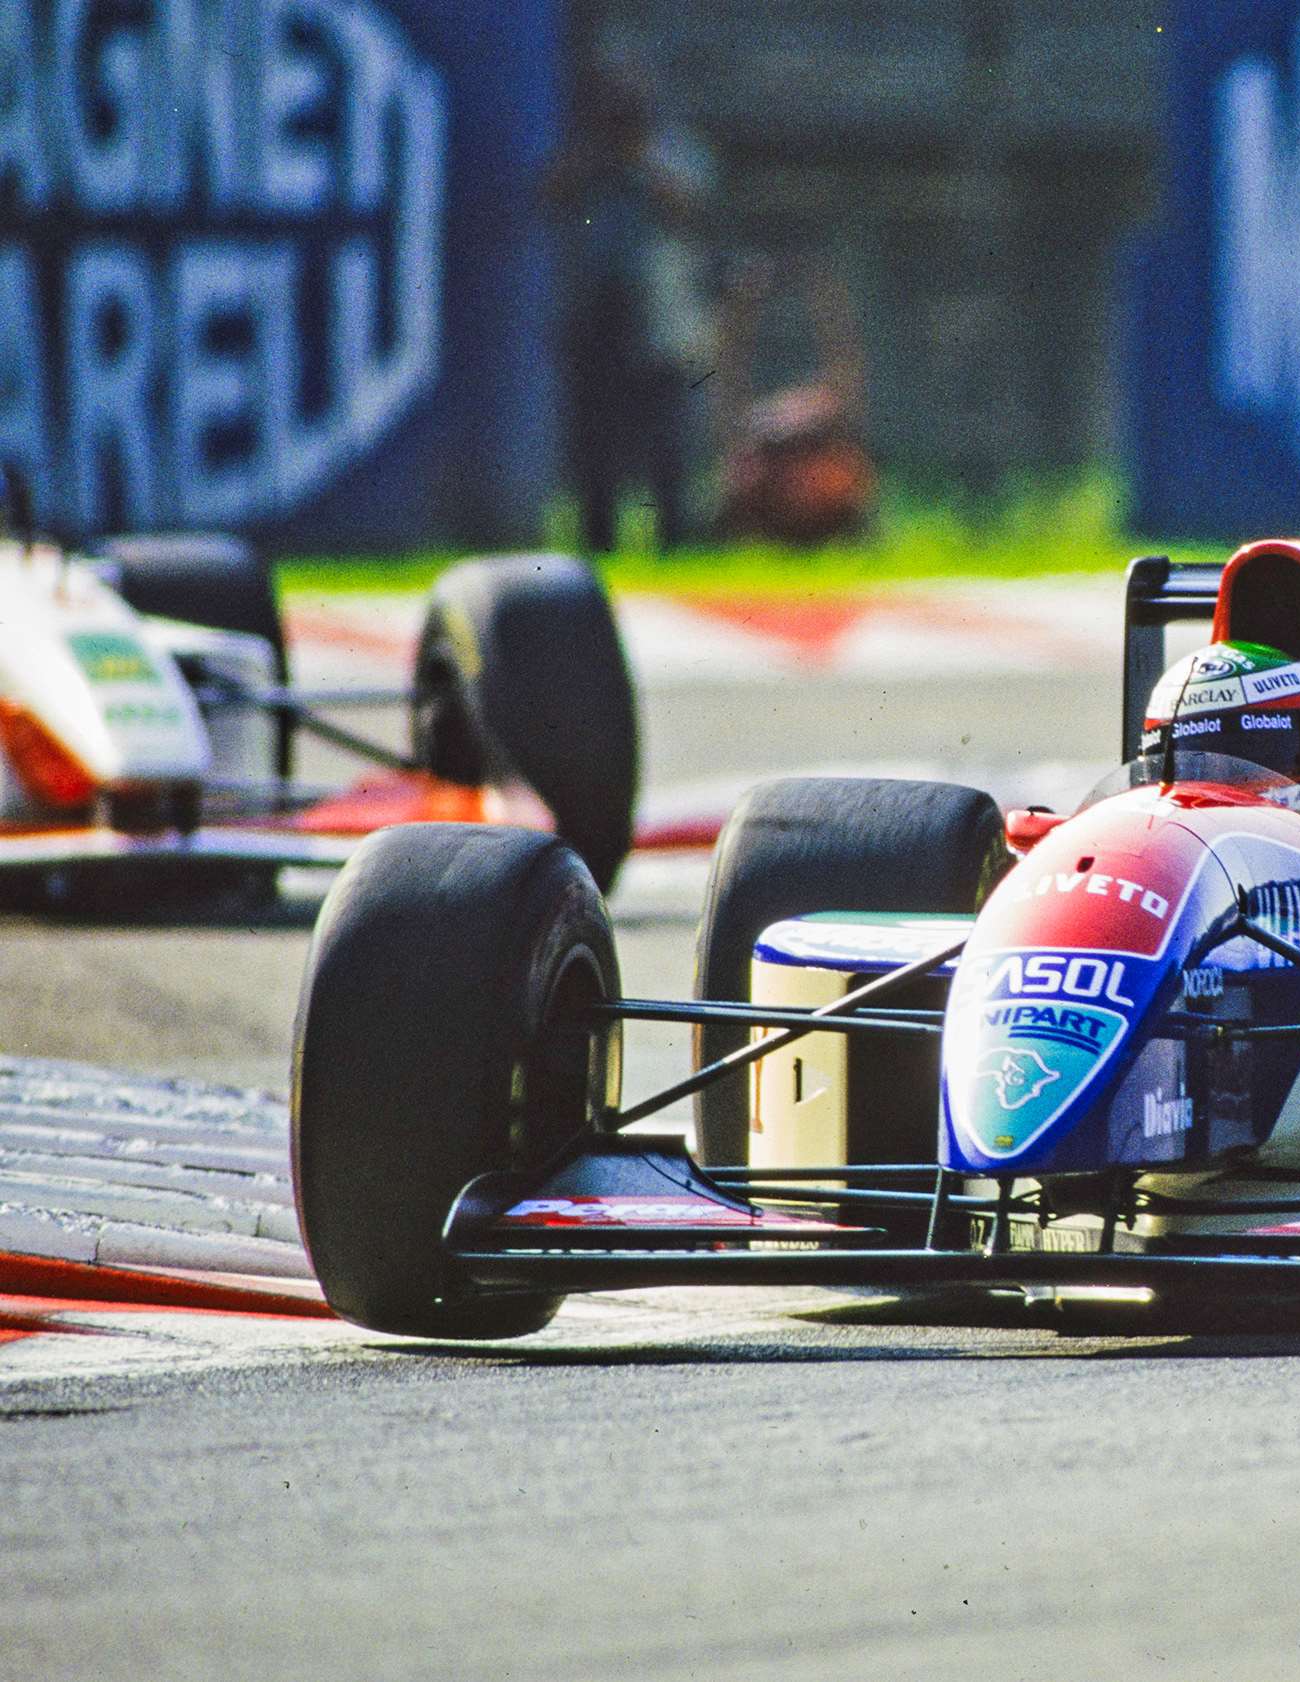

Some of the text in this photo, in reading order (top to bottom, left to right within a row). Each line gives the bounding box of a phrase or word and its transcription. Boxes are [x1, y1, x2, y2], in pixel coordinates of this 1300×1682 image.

[1172, 673, 1300, 712] ARCLAY ULIVETO
[972, 955, 1135, 1008] ASOL
